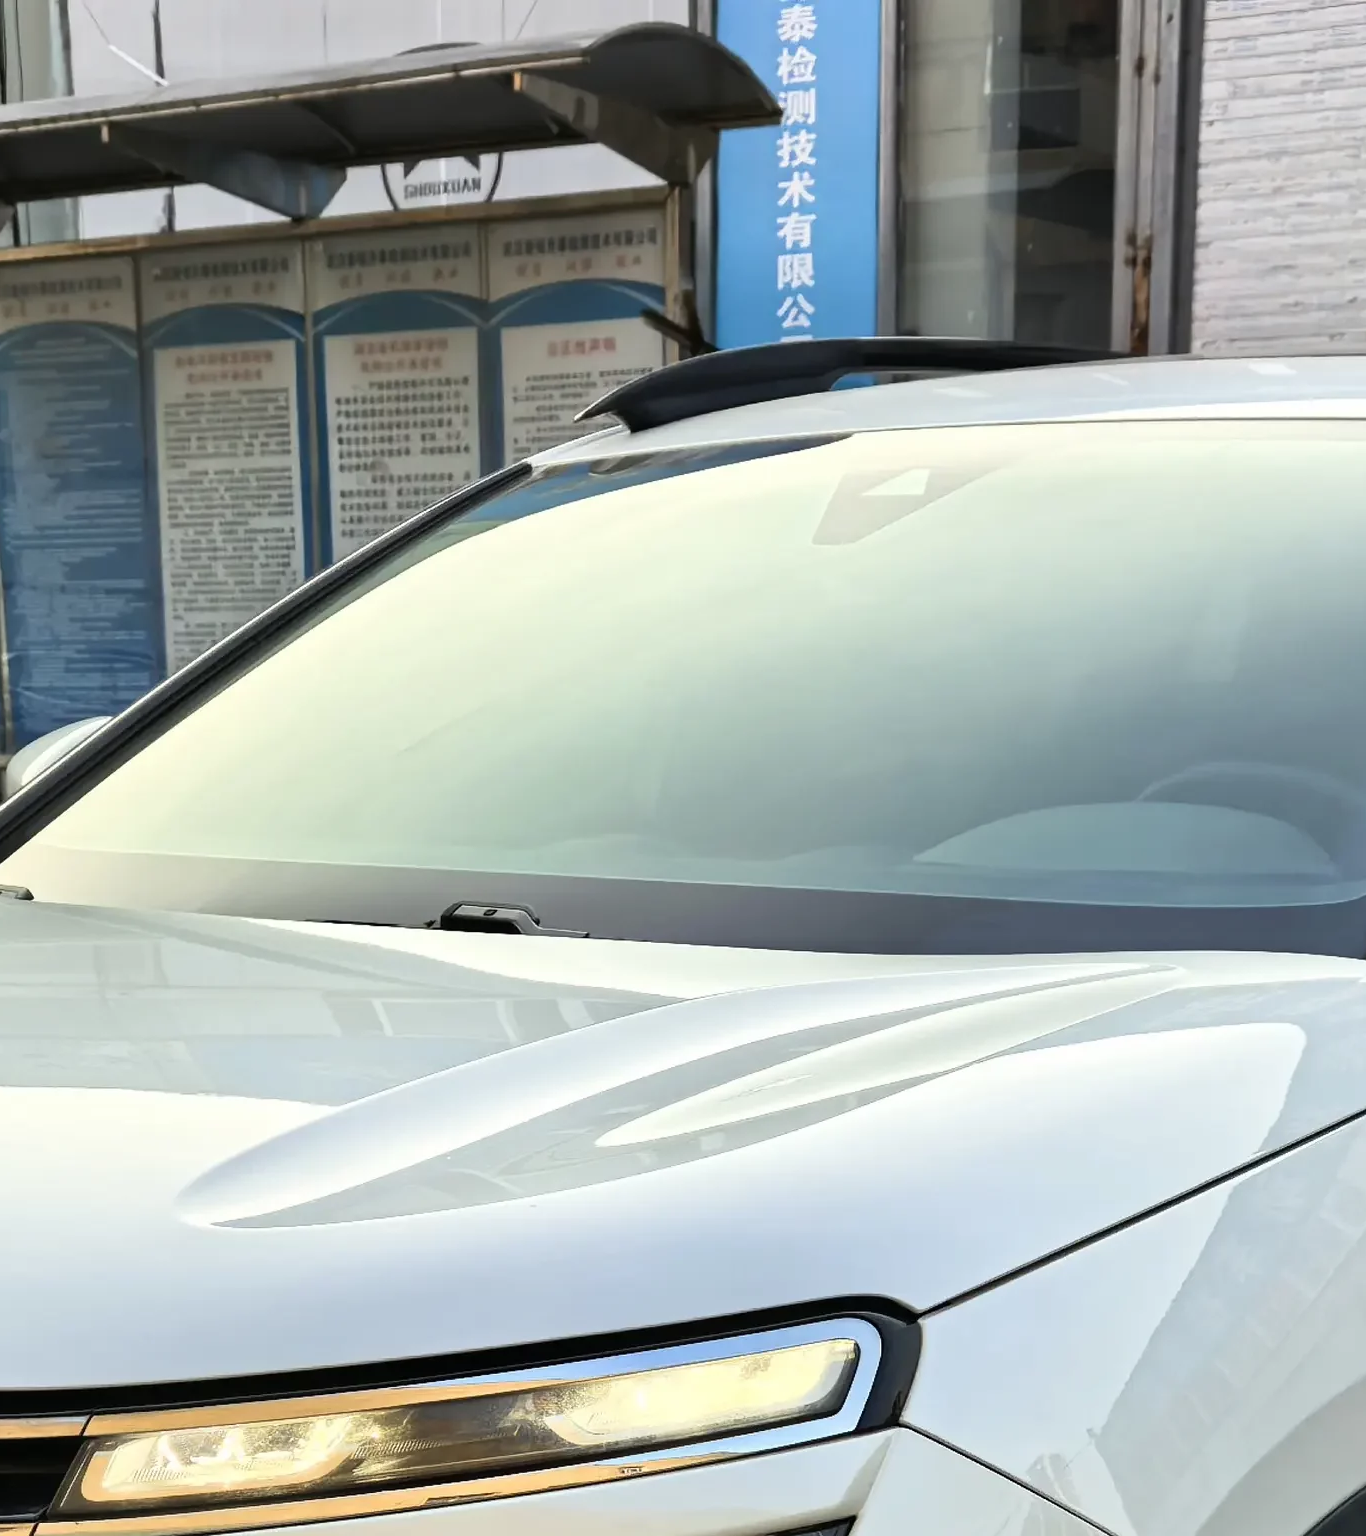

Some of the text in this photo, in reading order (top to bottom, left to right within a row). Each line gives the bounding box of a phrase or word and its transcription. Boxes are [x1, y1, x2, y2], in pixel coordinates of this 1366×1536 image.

[777, 0, 817, 342] 泰检测技术有限公
